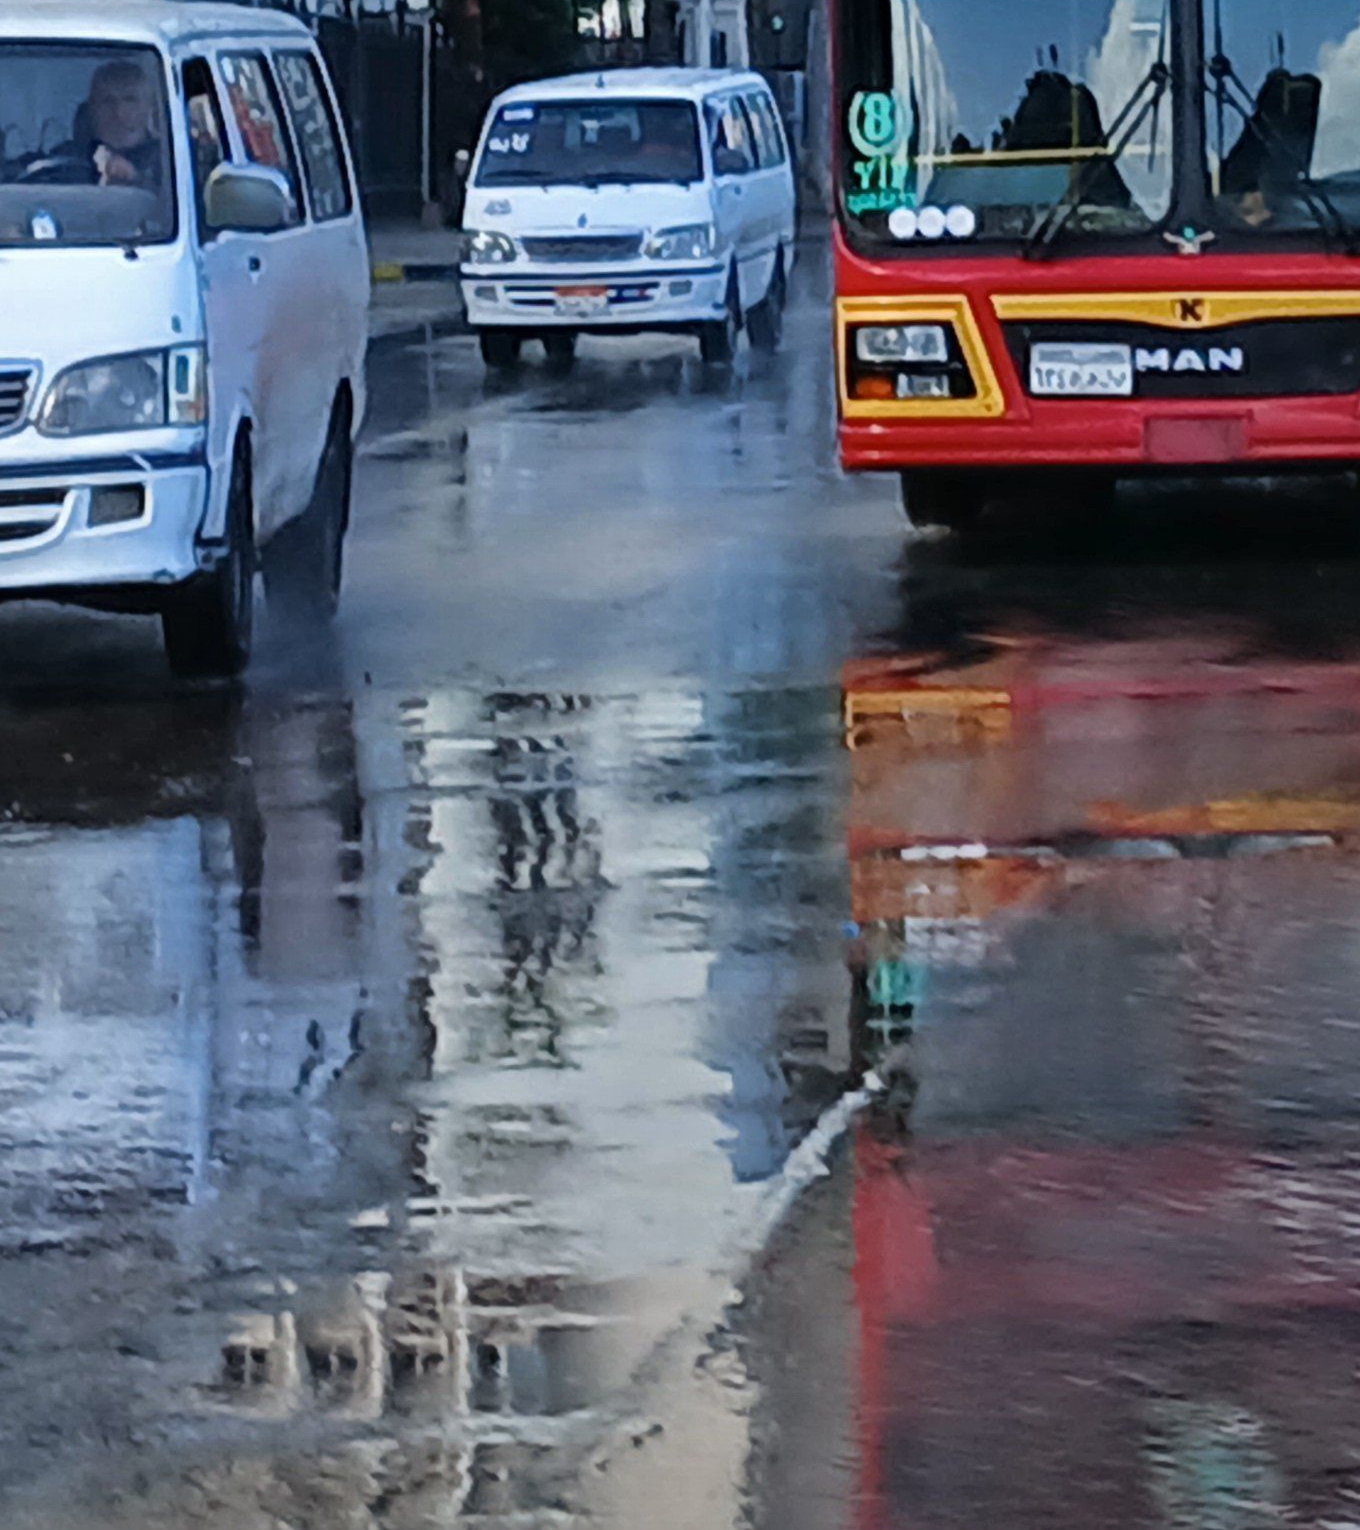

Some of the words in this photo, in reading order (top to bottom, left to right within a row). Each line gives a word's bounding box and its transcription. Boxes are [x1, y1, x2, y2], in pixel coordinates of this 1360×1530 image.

[864, 92, 894, 143] 8
[1180, 299, 1204, 321] K
[1135, 346, 1243, 372] MAN
